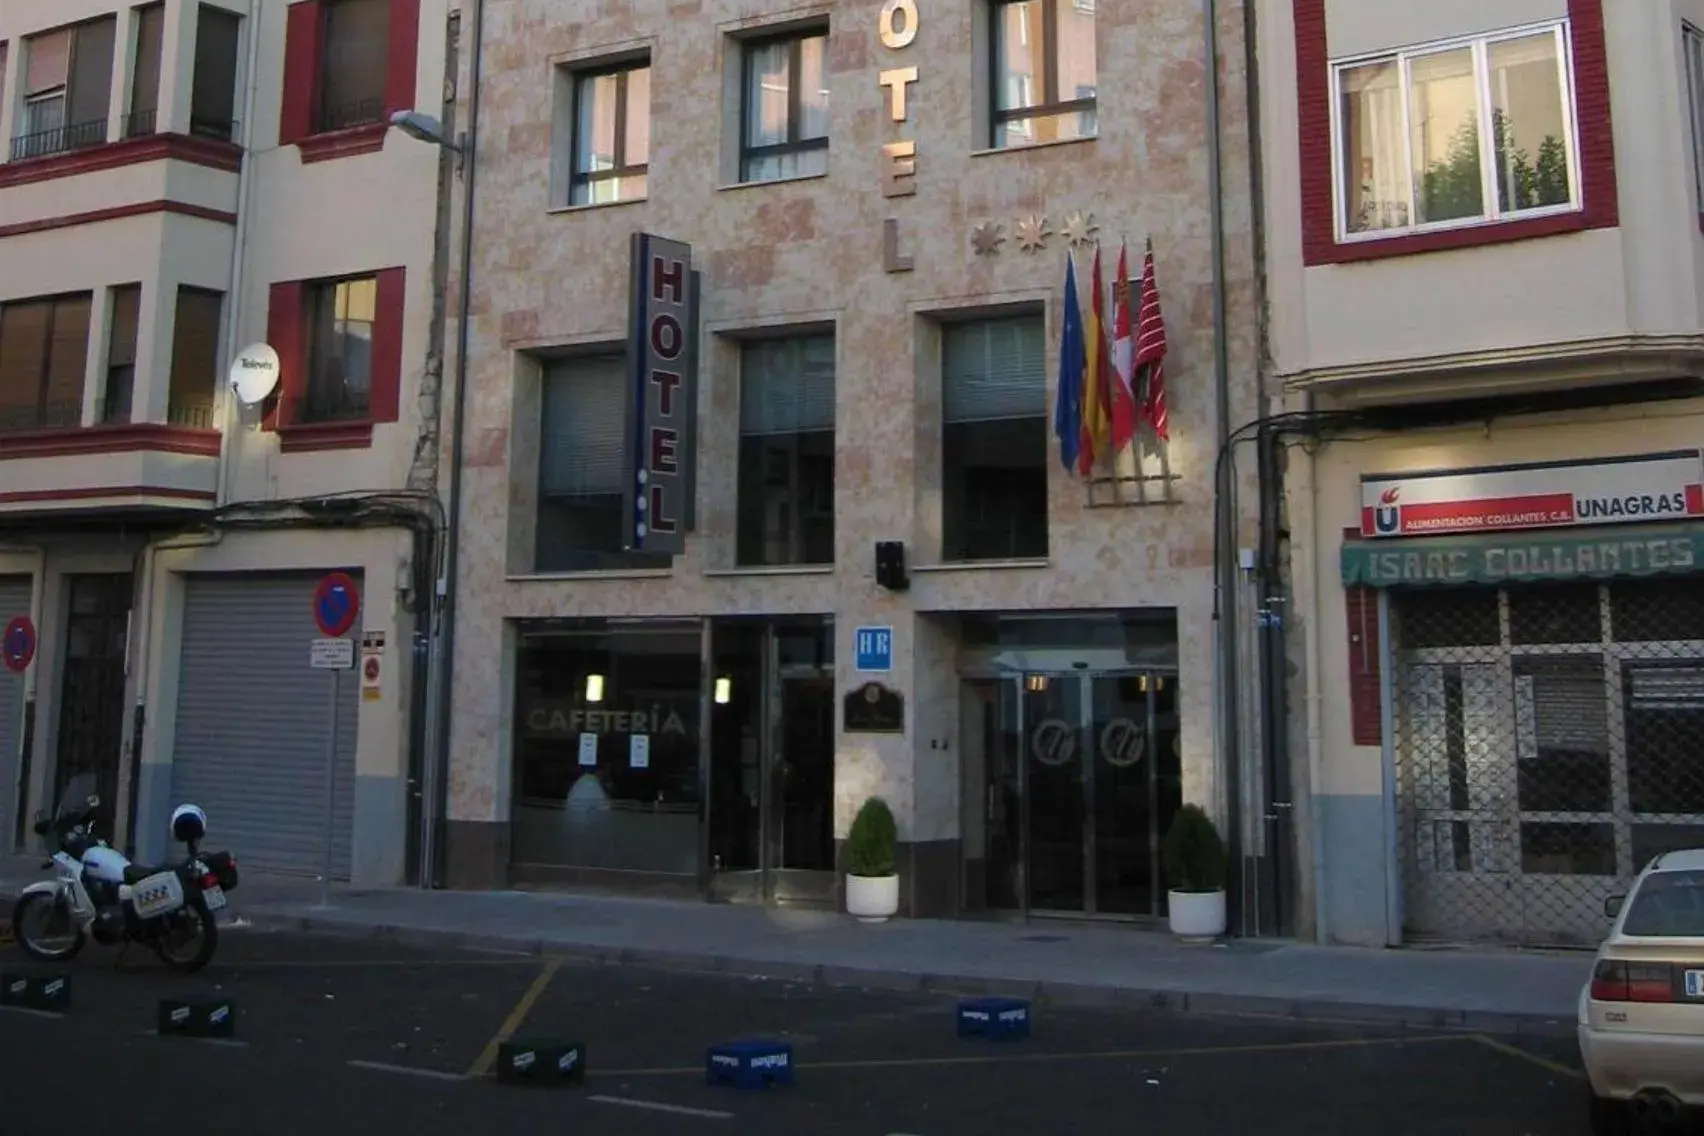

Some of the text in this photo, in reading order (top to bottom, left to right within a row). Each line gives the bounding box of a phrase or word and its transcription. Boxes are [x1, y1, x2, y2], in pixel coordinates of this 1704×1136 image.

[651, 255, 684, 535] HOTEL
[1487, 512, 1547, 525] COLLANTES
[1576, 493, 1685, 517] UNAGRAS
[1369, 537, 1695, 579] ISAAC COLLANTES
